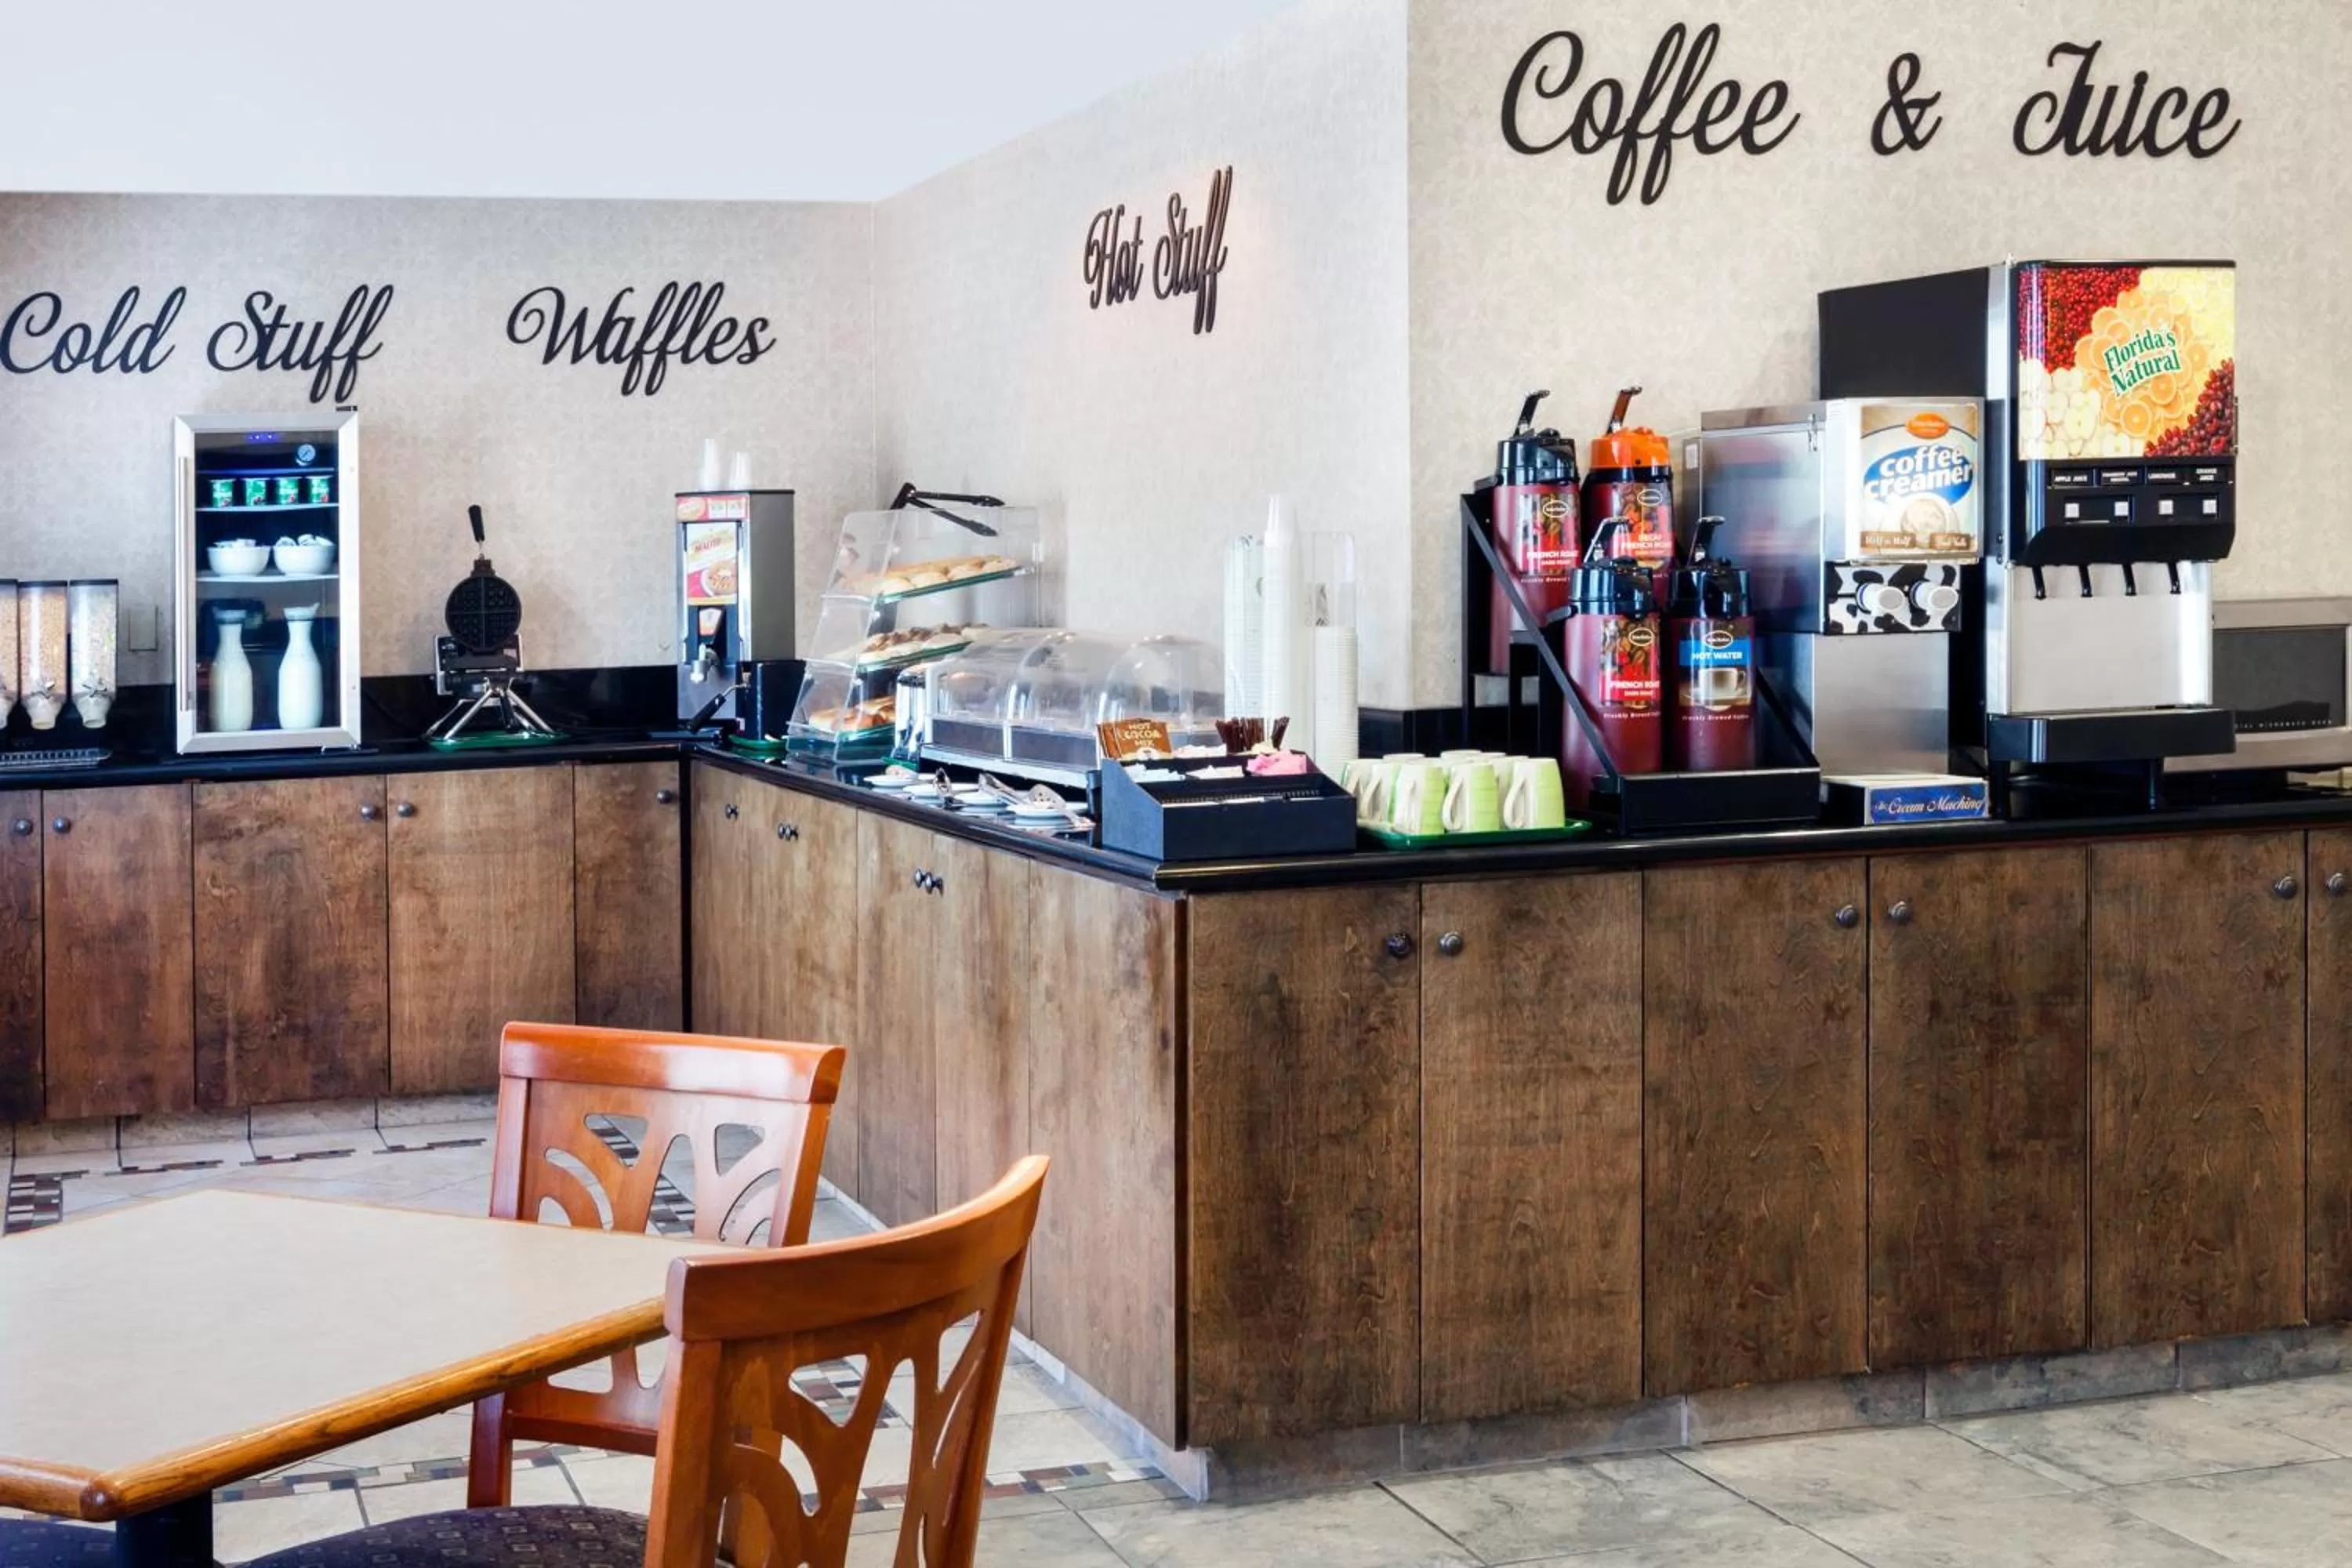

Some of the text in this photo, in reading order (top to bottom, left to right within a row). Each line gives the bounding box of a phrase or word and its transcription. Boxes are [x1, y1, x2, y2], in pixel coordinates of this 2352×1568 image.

[1501, 23, 2242, 205] Coffee & Juice
[1084, 165, 1233, 335] Hot Stuff
[0, 284, 394, 404] Cold Stuff
[506, 281, 777, 396] Waffles
[2111, 349, 2182, 397] Natural
[1864, 463, 1973, 500] creamer
[1880, 445, 1964, 477] coffee
[1692, 652, 1744, 661] HOT WATER
[1123, 729, 1161, 739] COCOA
